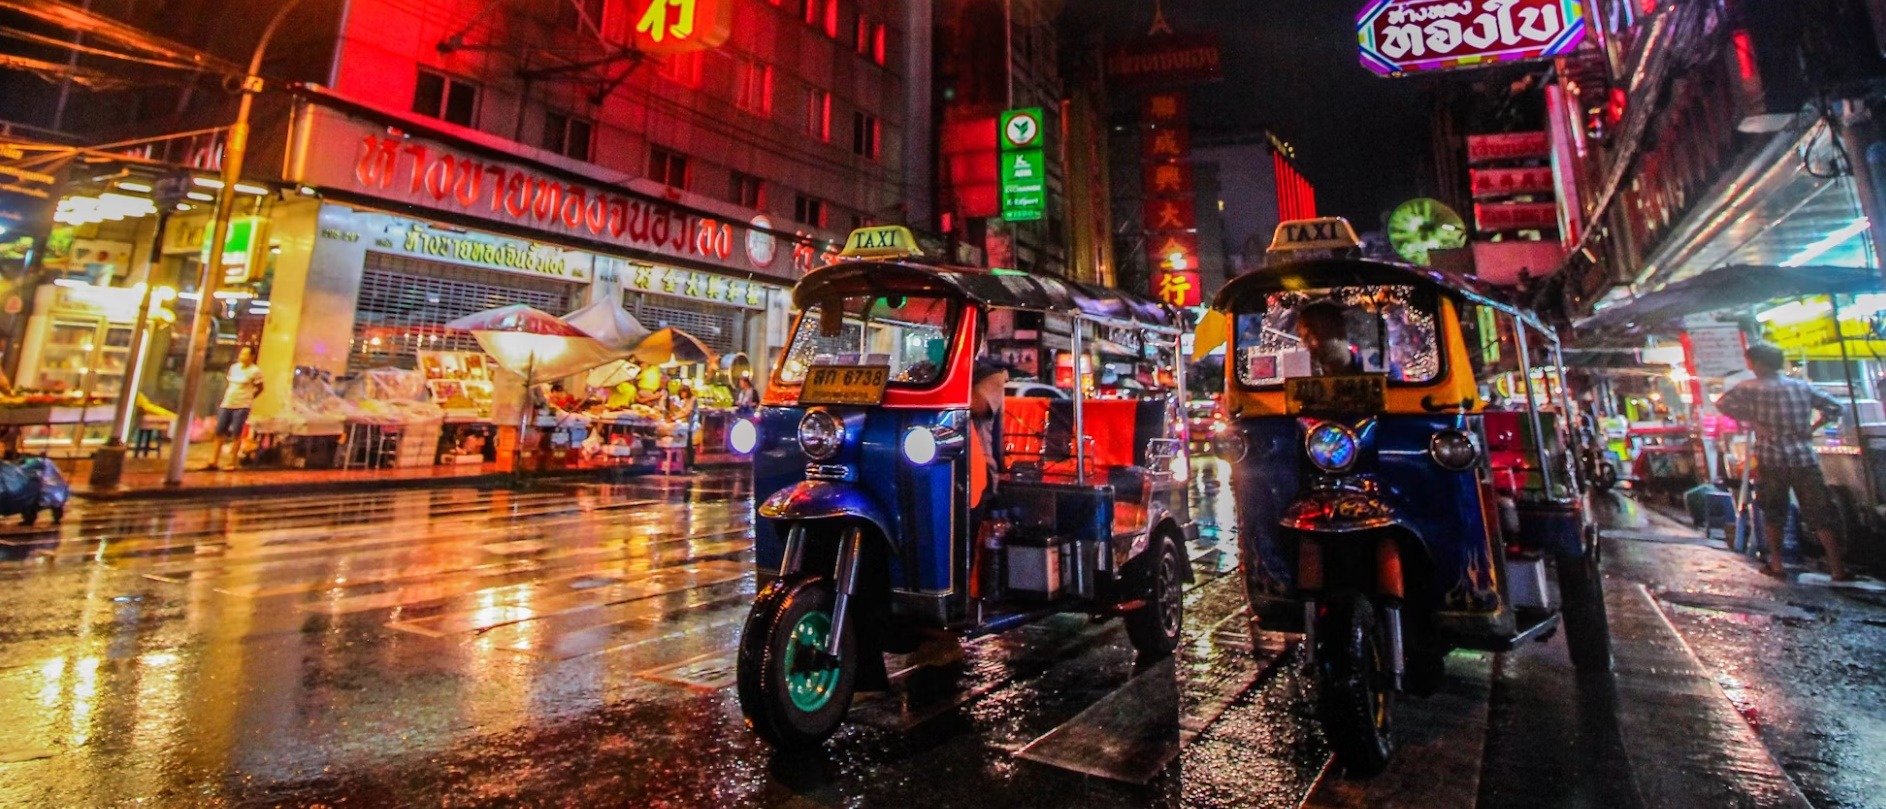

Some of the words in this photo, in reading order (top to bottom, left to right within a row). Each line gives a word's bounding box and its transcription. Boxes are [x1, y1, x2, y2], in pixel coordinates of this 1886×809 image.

[1381, 0, 1560, 59] ทองใบ
[855, 230, 897, 249] TAXI
[1284, 222, 1339, 242] TAXI
[843, 369, 882, 386] 6738
